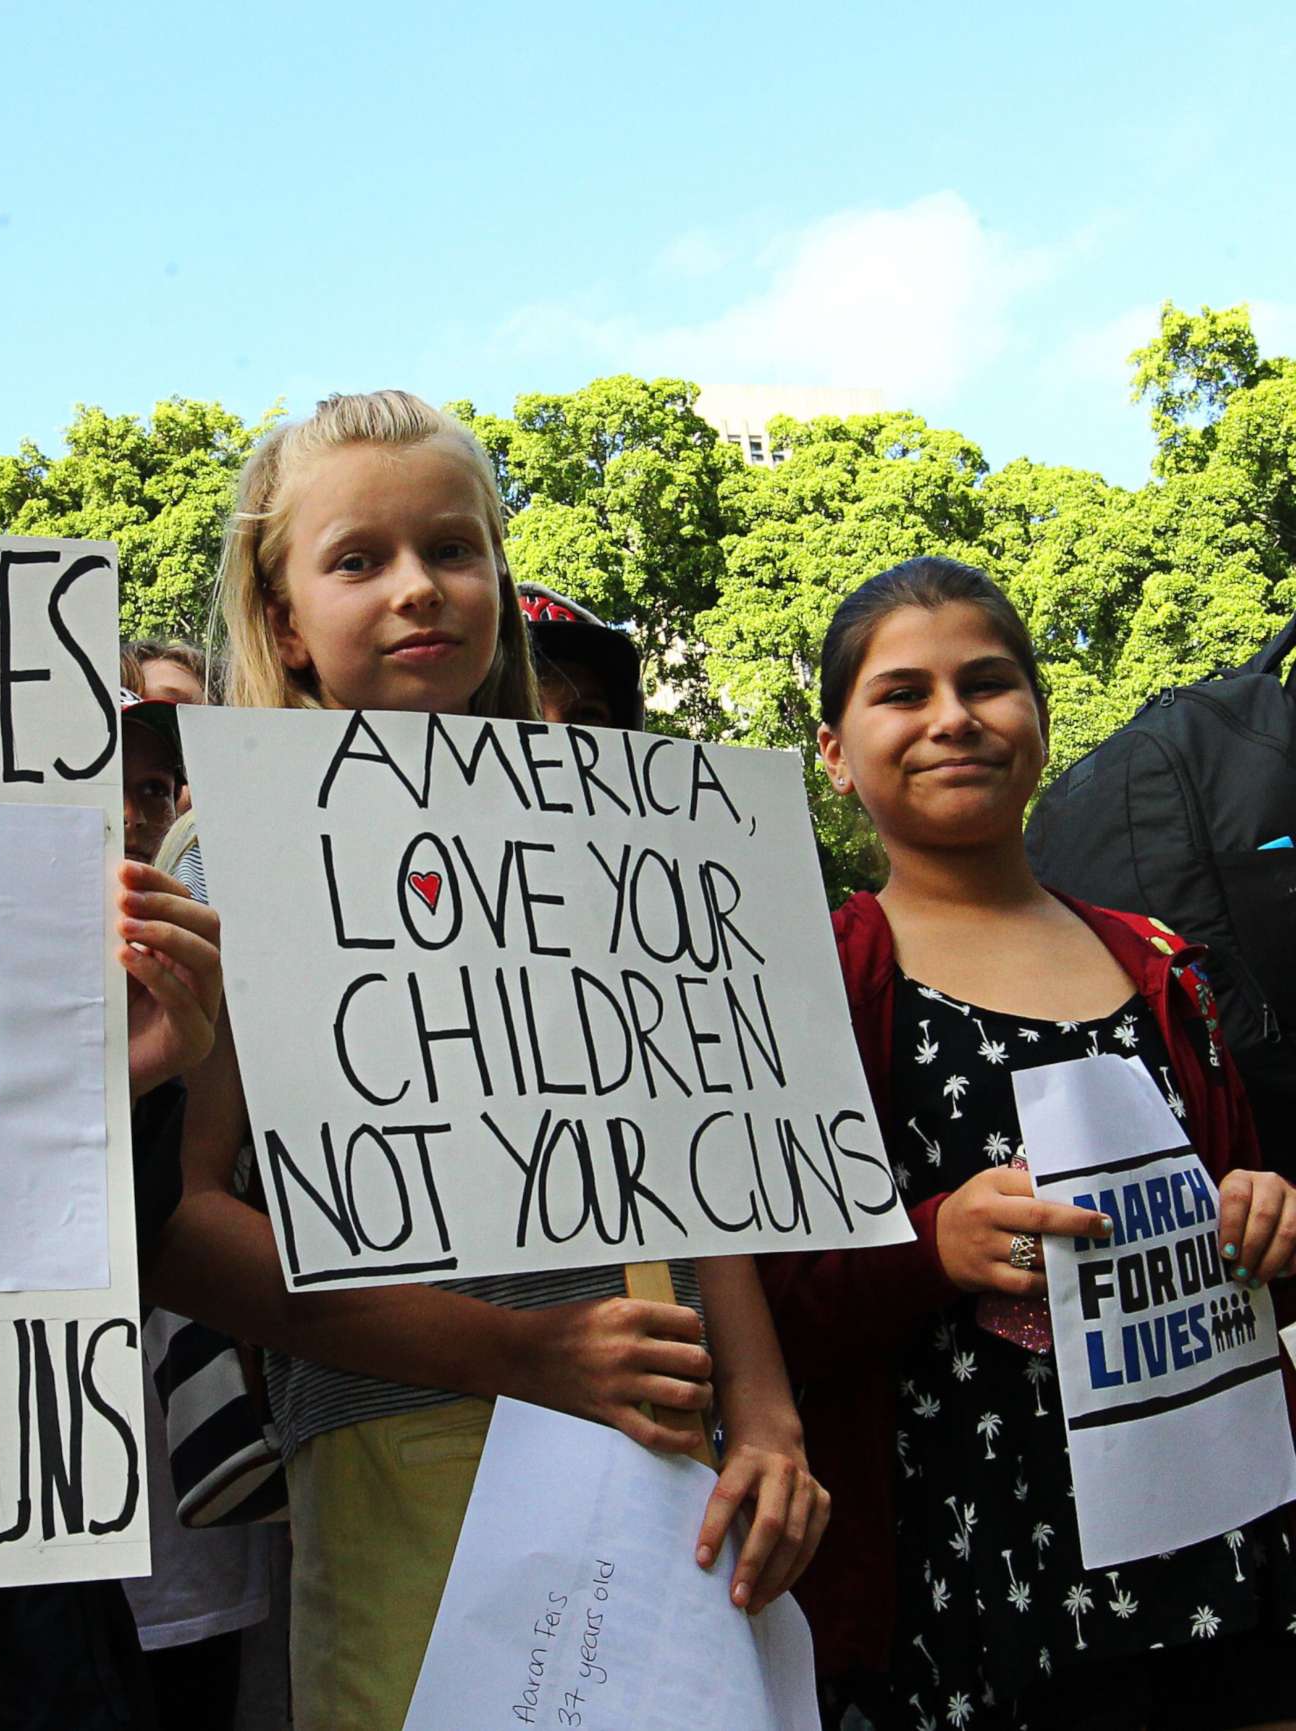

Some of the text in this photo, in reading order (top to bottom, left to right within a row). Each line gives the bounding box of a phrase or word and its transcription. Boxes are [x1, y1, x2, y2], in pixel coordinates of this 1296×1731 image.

[318, 711, 757, 836] AMERICA,
[321, 832, 765, 972] LOVE YOUR
[333, 965, 787, 1106] CHILDREN
[265, 1108, 898, 1274] NOT YOUR GUNS
[1072, 1167, 1217, 1253] MARCH
[1077, 1230, 1234, 1321] FOR OU
[1085, 1303, 1212, 1390] LIVES
[558, 1559, 615, 1728] 37 years old
